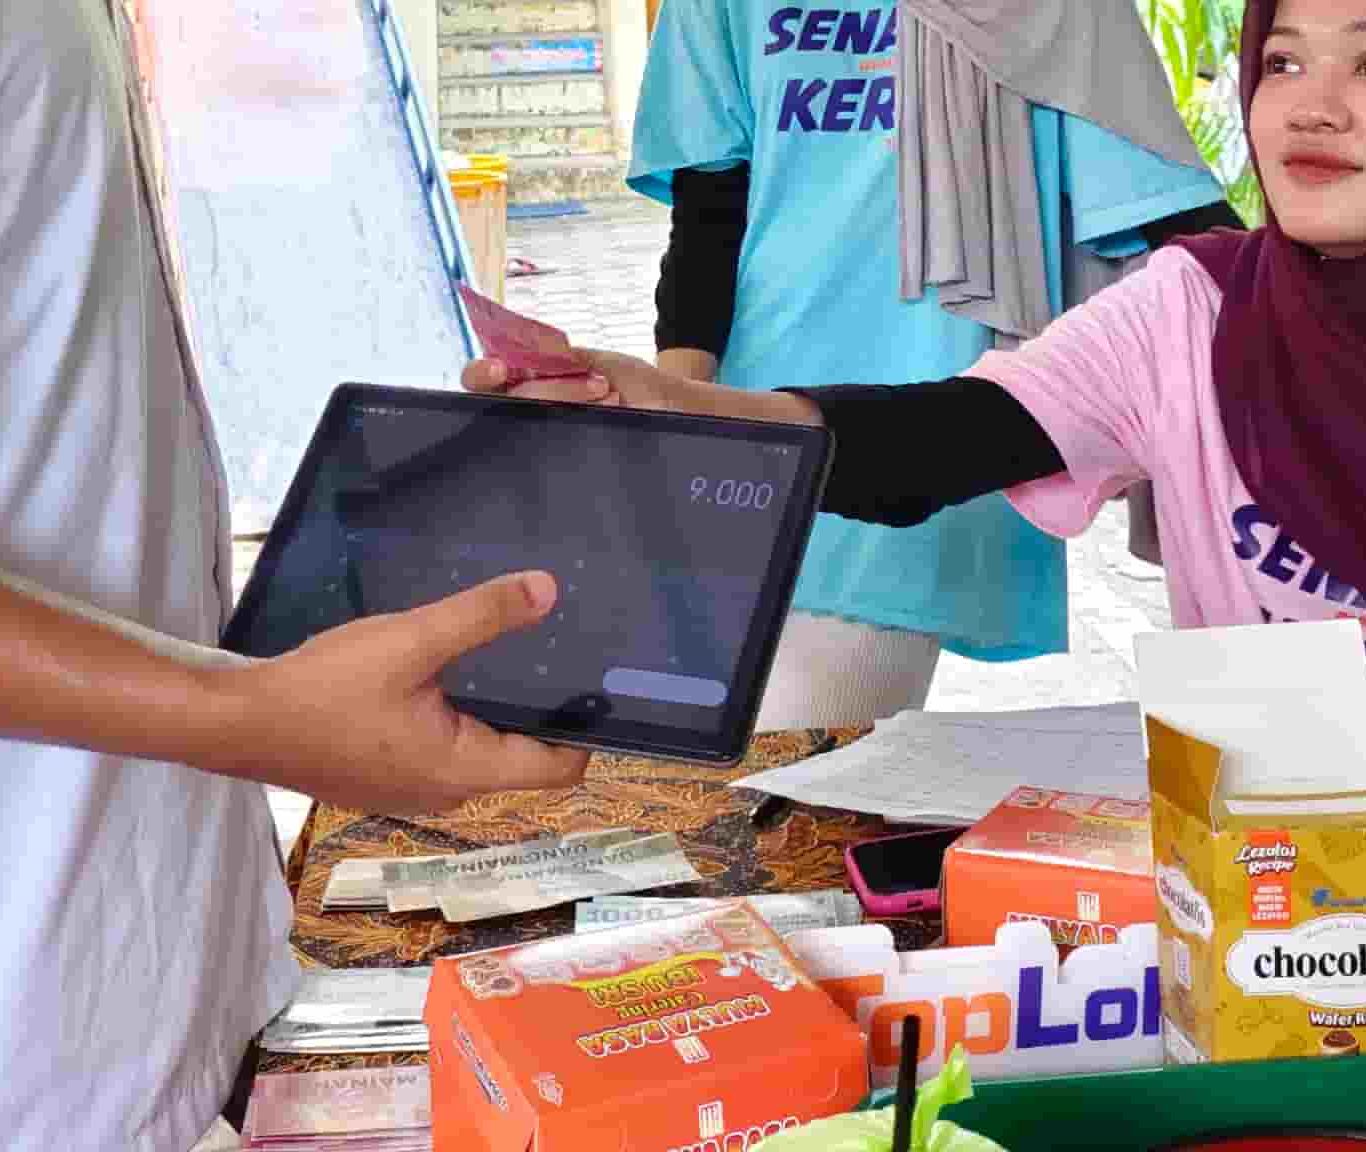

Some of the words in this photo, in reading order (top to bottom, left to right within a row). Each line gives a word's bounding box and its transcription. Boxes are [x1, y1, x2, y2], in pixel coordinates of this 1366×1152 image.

[690, 477, 774, 510] 9.000
[1309, 1010, 1353, 1028] Wafer
[576, 1019, 669, 1058] RASA
